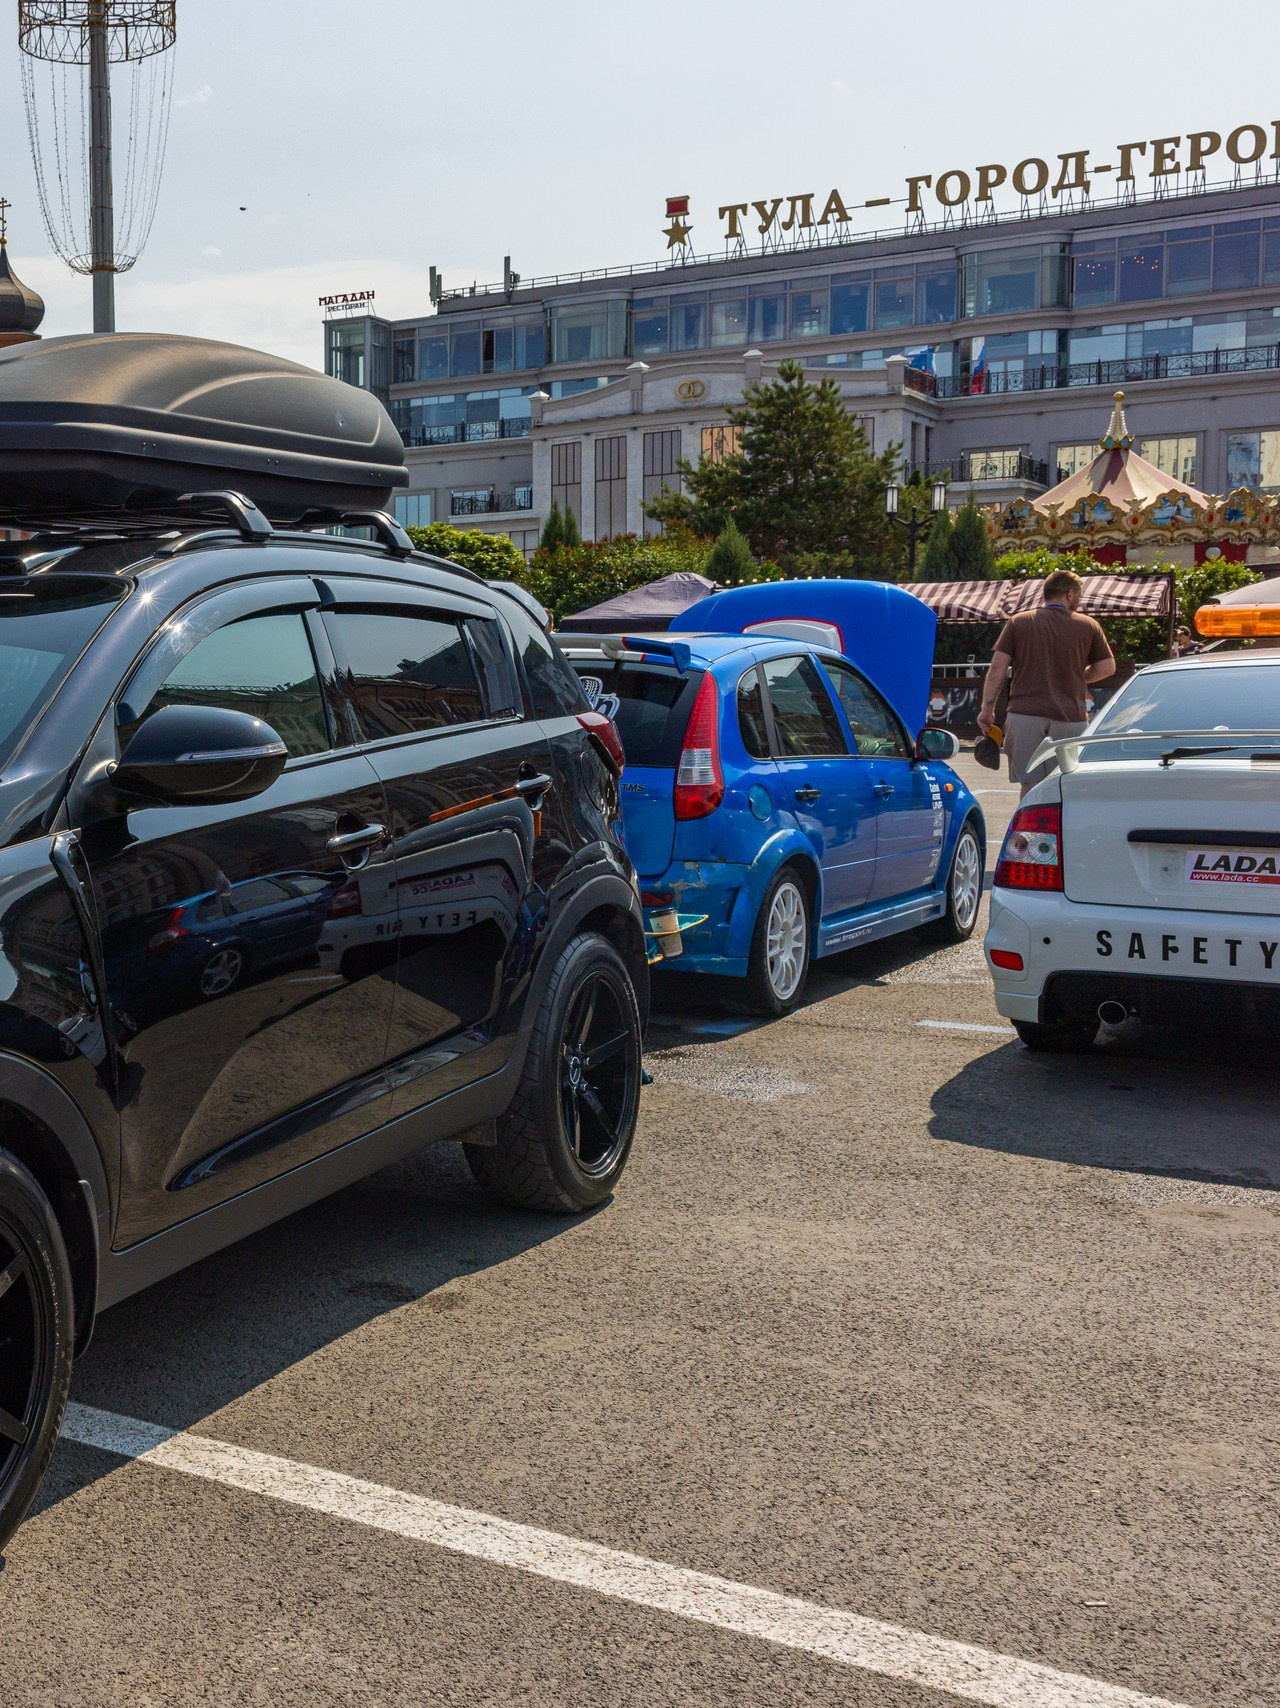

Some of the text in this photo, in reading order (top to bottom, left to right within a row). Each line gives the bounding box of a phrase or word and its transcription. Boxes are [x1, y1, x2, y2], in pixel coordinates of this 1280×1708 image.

[719, 189, 852, 239] ТУЛА
[905, 120, 1280, 213] ГОРОД-ГЕРО
[318, 290, 375, 306] МАГАДАН
[327, 302, 366, 312] РЕСТОРАН
[621, 783, 645, 792] TMS
[1193, 854, 1276, 873] LADA
[1192, 872, 1260, 883] www.lada.cc
[1096, 930, 1279, 969] SAFETY
